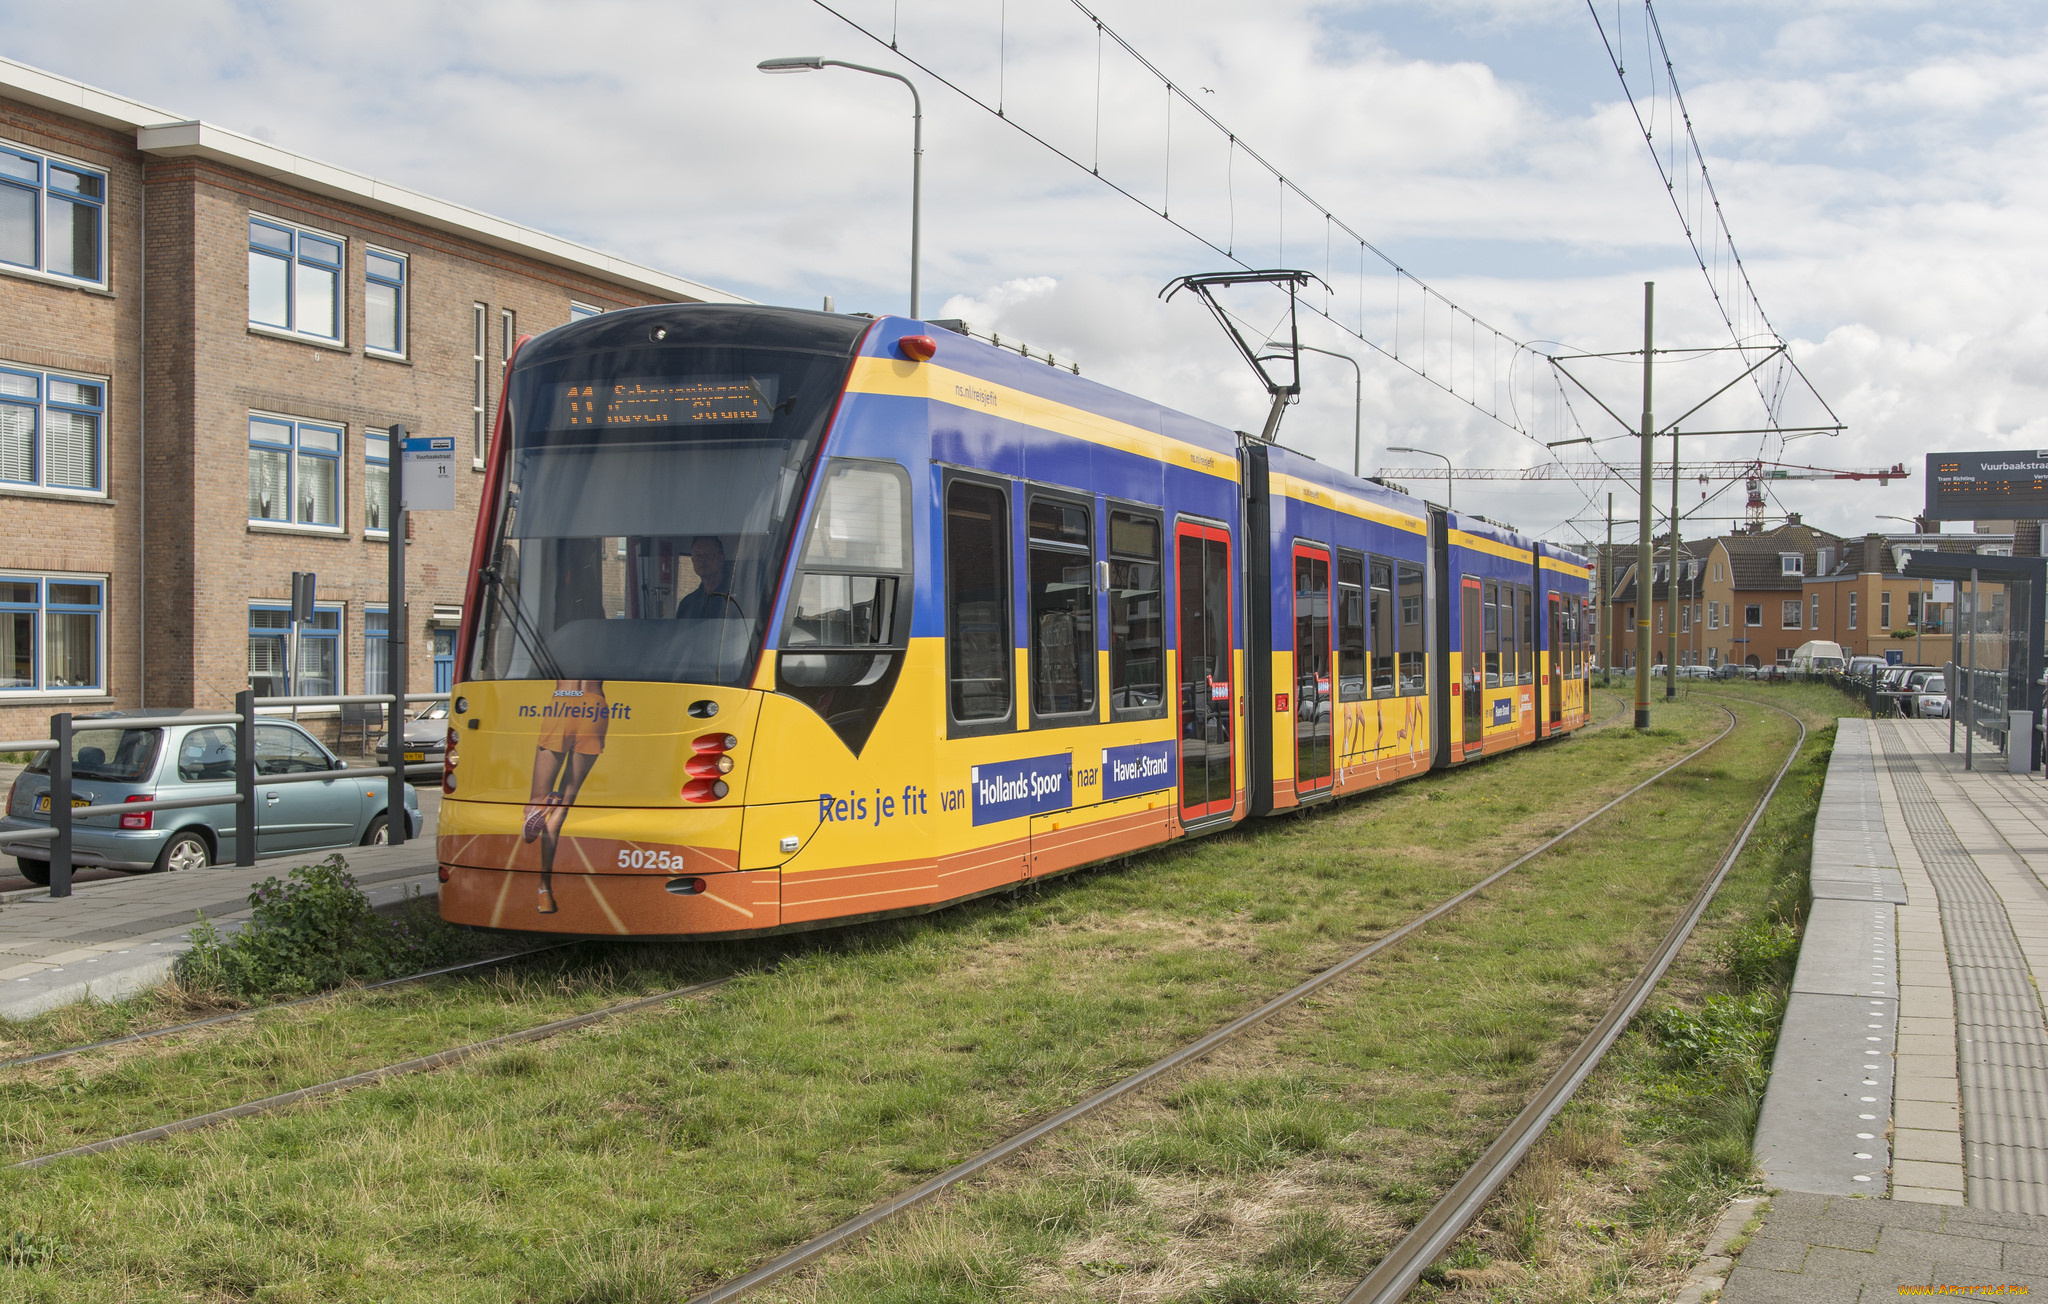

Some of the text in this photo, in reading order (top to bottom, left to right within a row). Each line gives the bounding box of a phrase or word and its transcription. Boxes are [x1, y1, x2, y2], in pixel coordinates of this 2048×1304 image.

[955, 385, 998, 407] ns.nl/reisjefit
[438, 465, 446, 474] 11
[518, 701, 632, 723] ns.nl/reisjefit
[819, 751, 1168, 827] Reis je fit van Hollands Spoor naar Haven-Strand
[617, 849, 684, 870] 5025a
